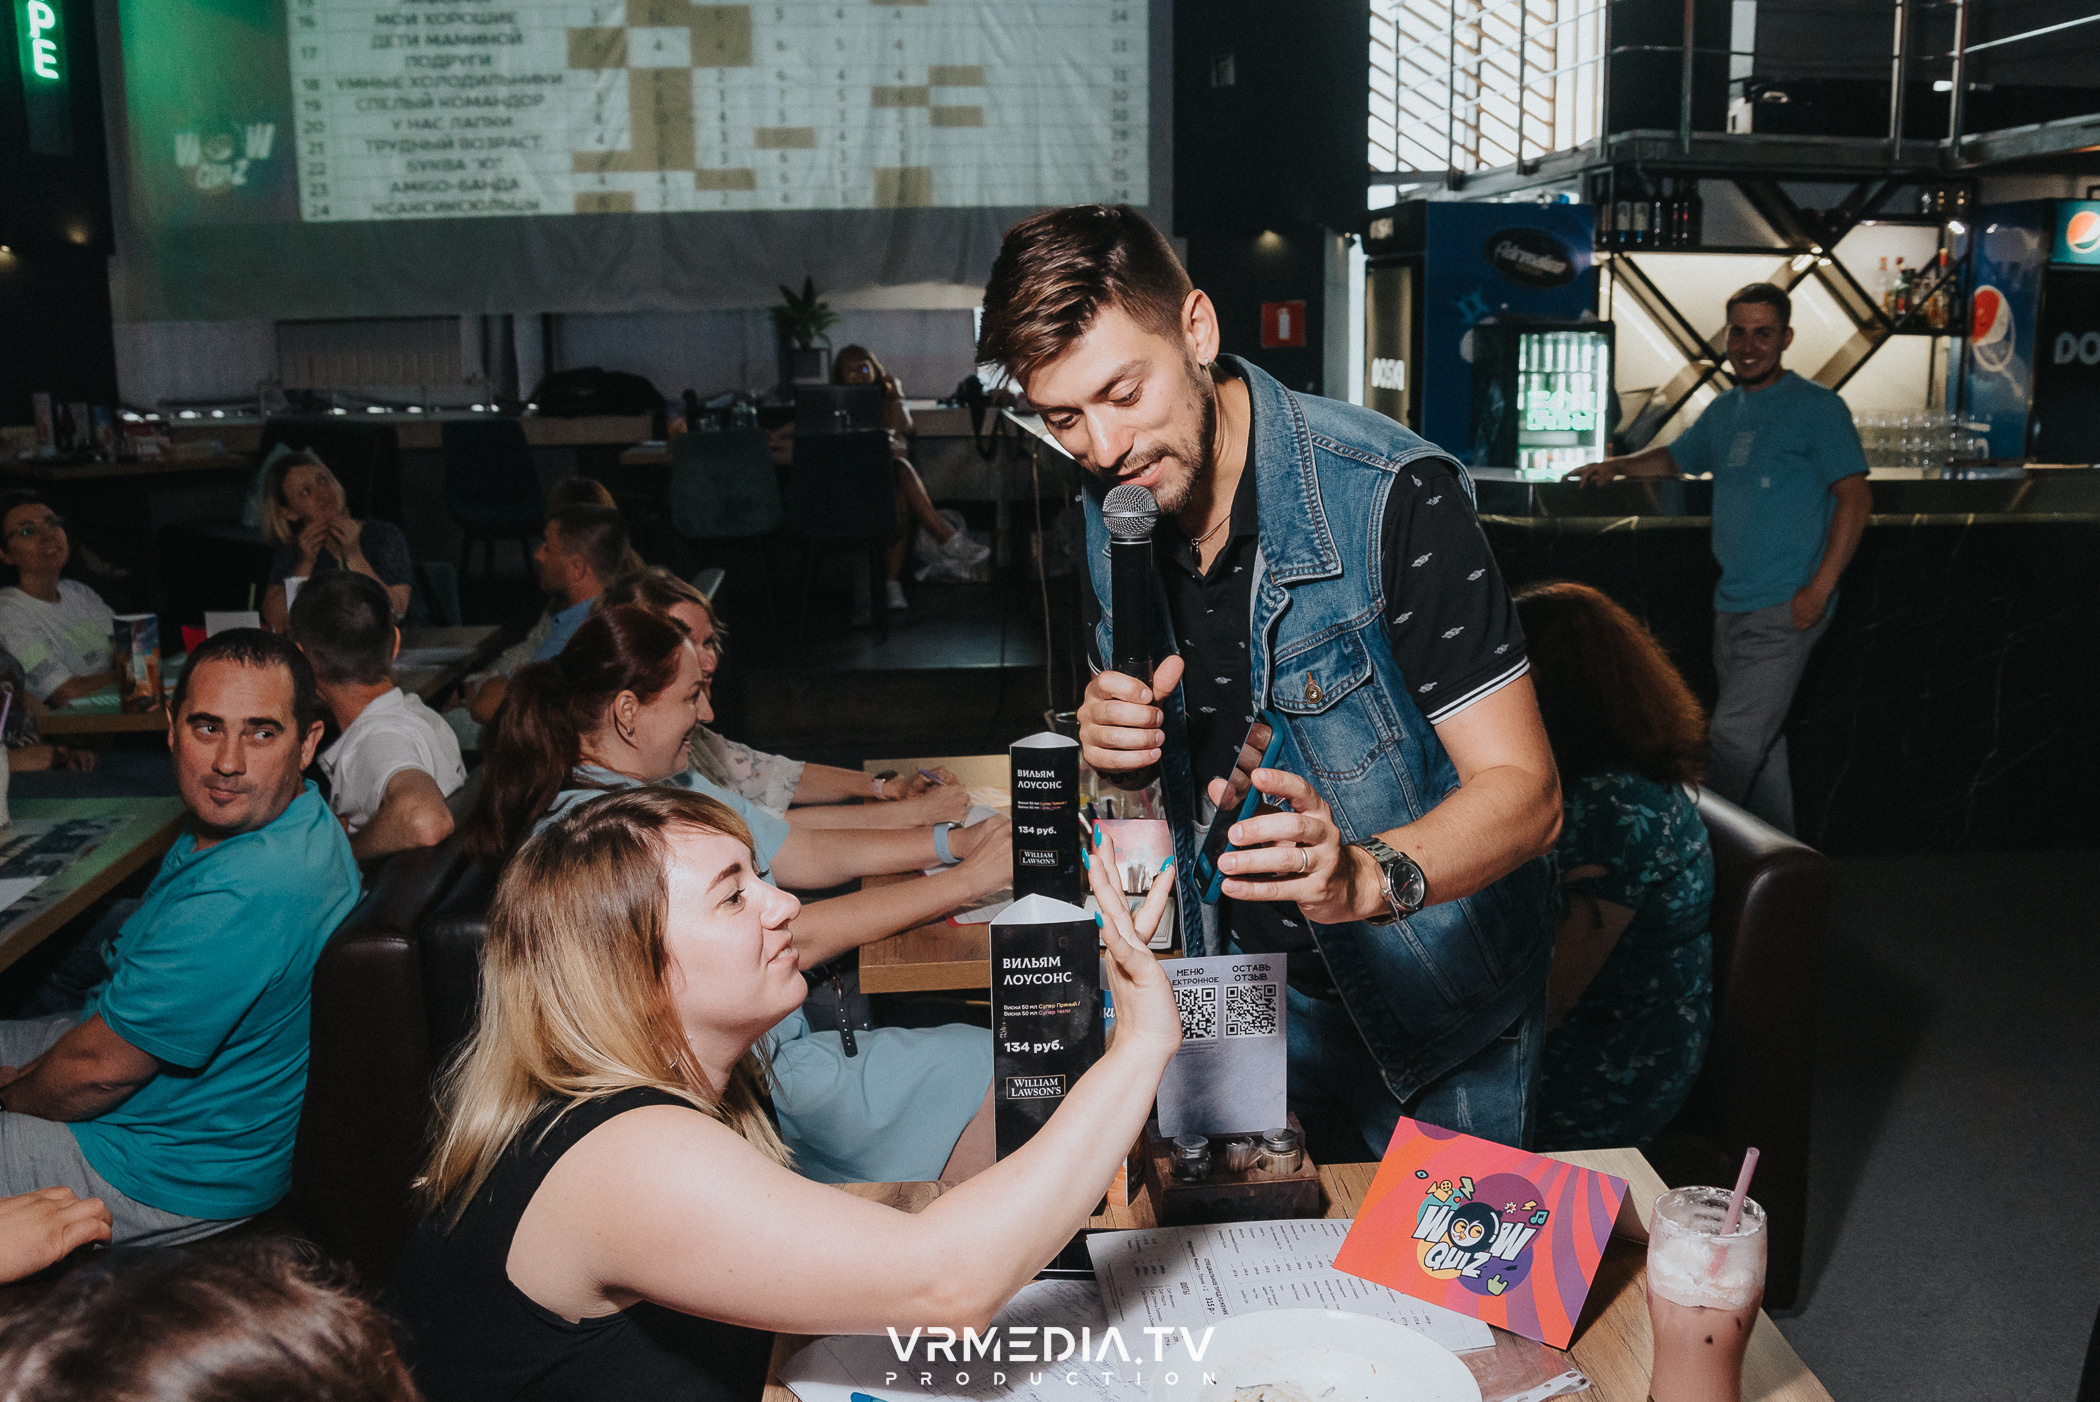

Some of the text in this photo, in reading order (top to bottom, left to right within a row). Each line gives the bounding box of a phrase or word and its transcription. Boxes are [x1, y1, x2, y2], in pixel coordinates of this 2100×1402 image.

[1017, 769, 1055, 778] ВИЛЬЯМ
[1017, 780, 1062, 789] ЛОУСОНС
[1018, 826, 1057, 836] 134 руб.
[1023, 851, 1054, 859] WILLIAM
[1003, 956, 1061, 970] ВИЛЬЯМ
[1176, 968, 1205, 977] МЕНЮ
[1232, 964, 1271, 973] ОСТАВЬ
[1004, 972, 1072, 986] ЛОУСОНС
[1172, 977, 1219, 986] ЕКТРОННОЕ
[1234, 974, 1268, 982] ОТЗЫВ
[1038, 1003, 1056, 1011] Супер
[1004, 1040, 1064, 1054] 134 руб.
[1013, 1077, 1059, 1088] WILLIAM
[1011, 1086, 1061, 1098] LAWSON'S
[1424, 1241, 1493, 1279] QUIZ
[1204, 1297, 1215, 1308] 315
